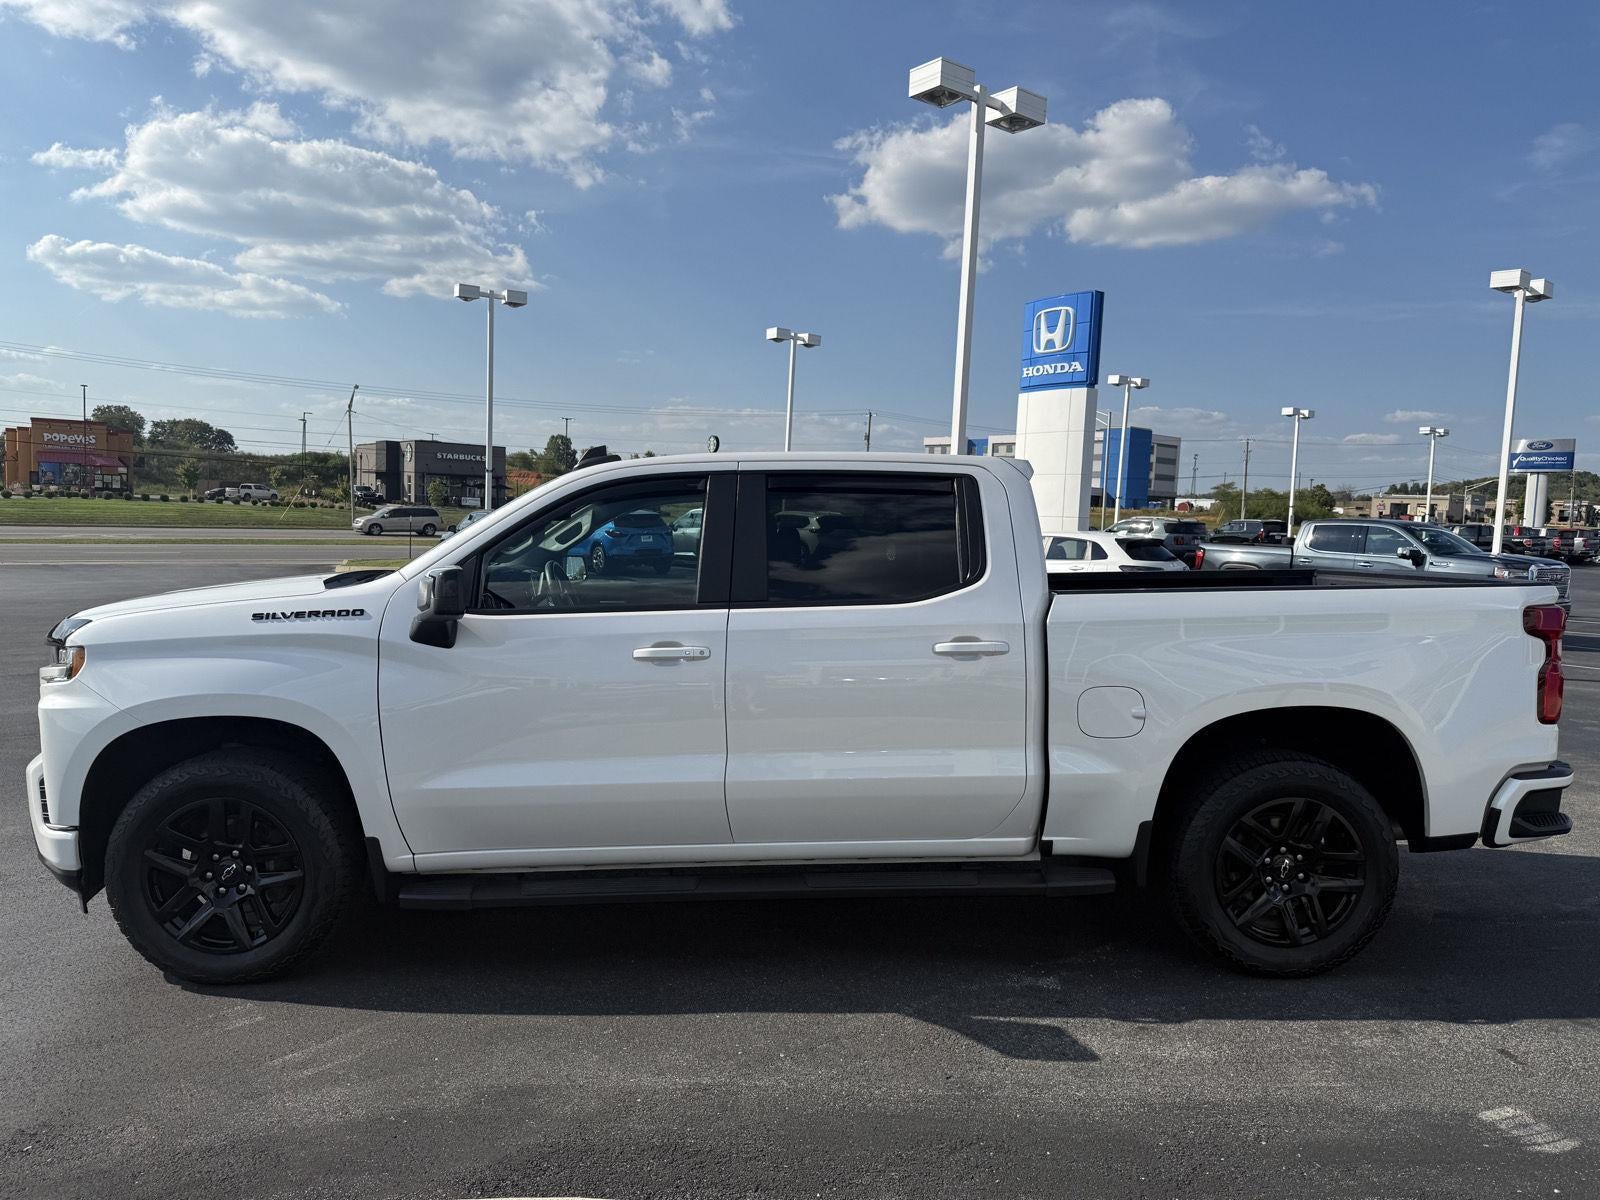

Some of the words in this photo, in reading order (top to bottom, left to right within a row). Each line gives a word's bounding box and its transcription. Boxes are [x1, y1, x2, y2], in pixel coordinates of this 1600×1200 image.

[1022, 361, 1083, 377] HONDA
[437, 452, 487, 462] STARBUCKS
[251, 609, 365, 620] SILVERADO
